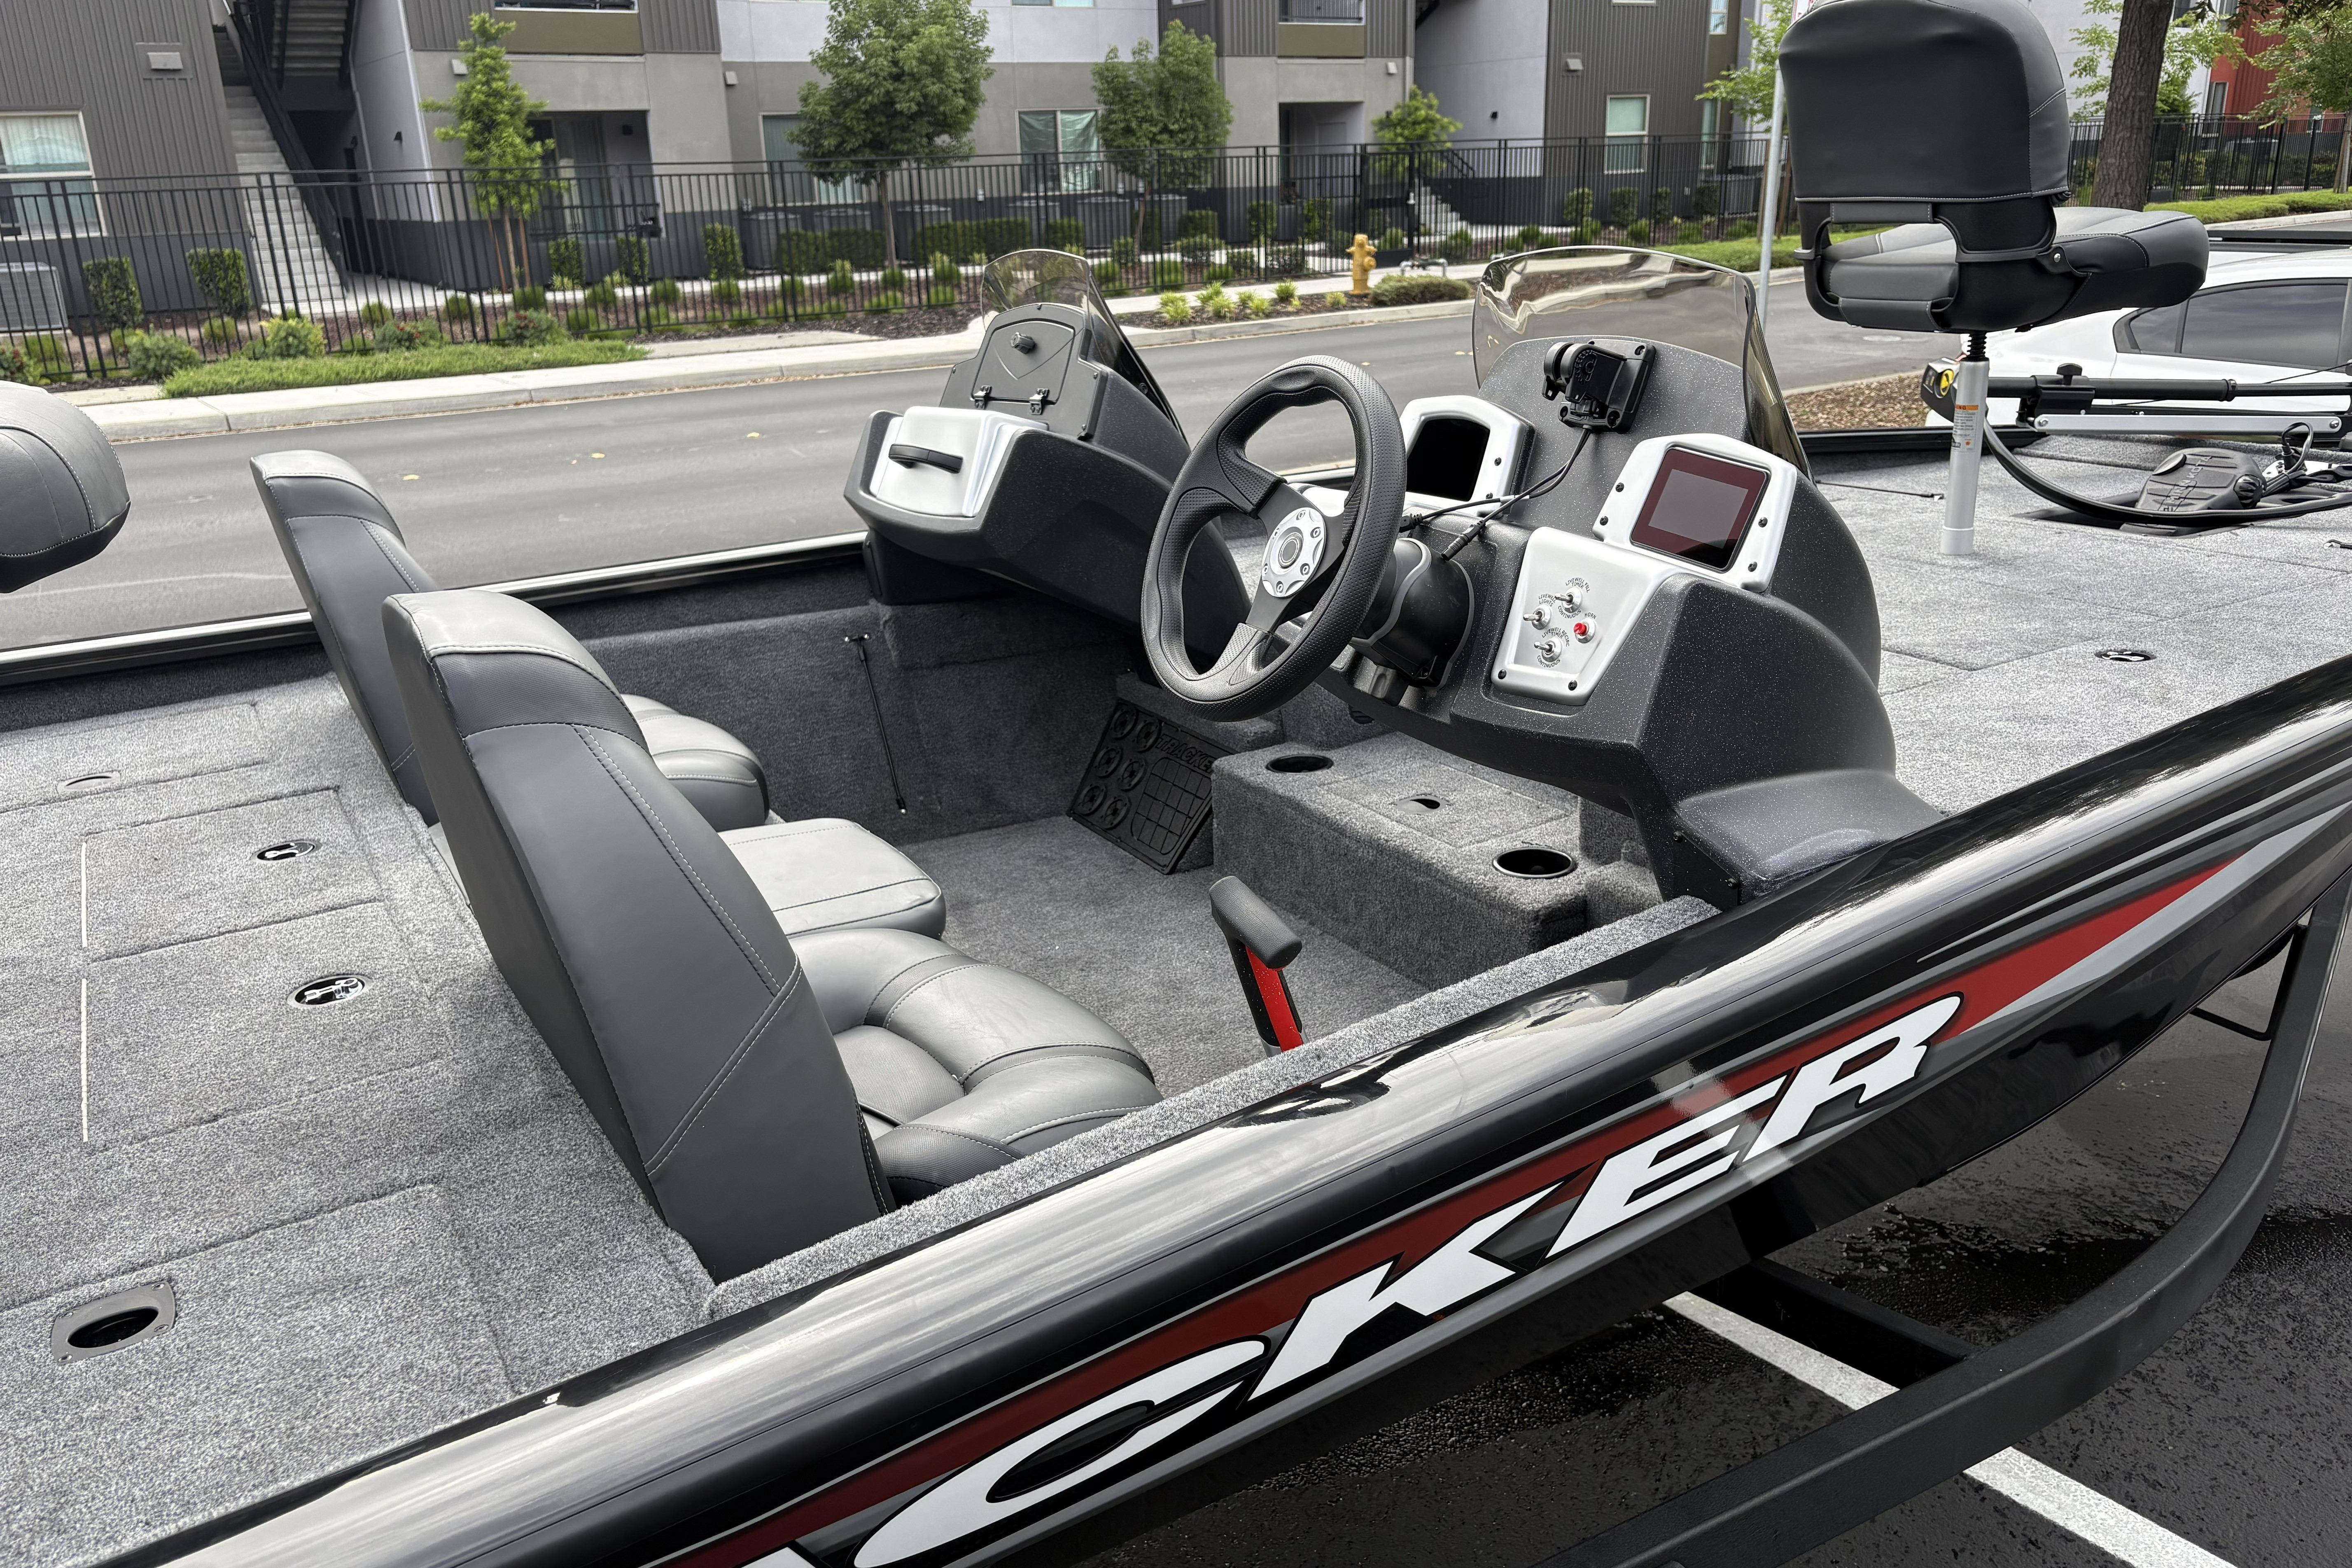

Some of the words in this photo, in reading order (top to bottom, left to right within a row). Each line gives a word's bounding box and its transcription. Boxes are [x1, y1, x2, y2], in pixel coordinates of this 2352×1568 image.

[2186, 456, 2212, 479] KOTA
[1566, 577, 1584, 586] LIVEWELL
[1539, 593, 1556, 603] LIVEWELL
[1539, 599, 1554, 607] LIGHTS
[1558, 605, 1581, 618] CONTINUOUS
[1542, 627, 1561, 638] LIVEWELL
[1561, 630, 1570, 647] RECIRC
[1537, 655, 1561, 668] CONTINUOUS
[1155, 733, 1216, 774] TRACKE
[741, 996, 1962, 1568] CKER
